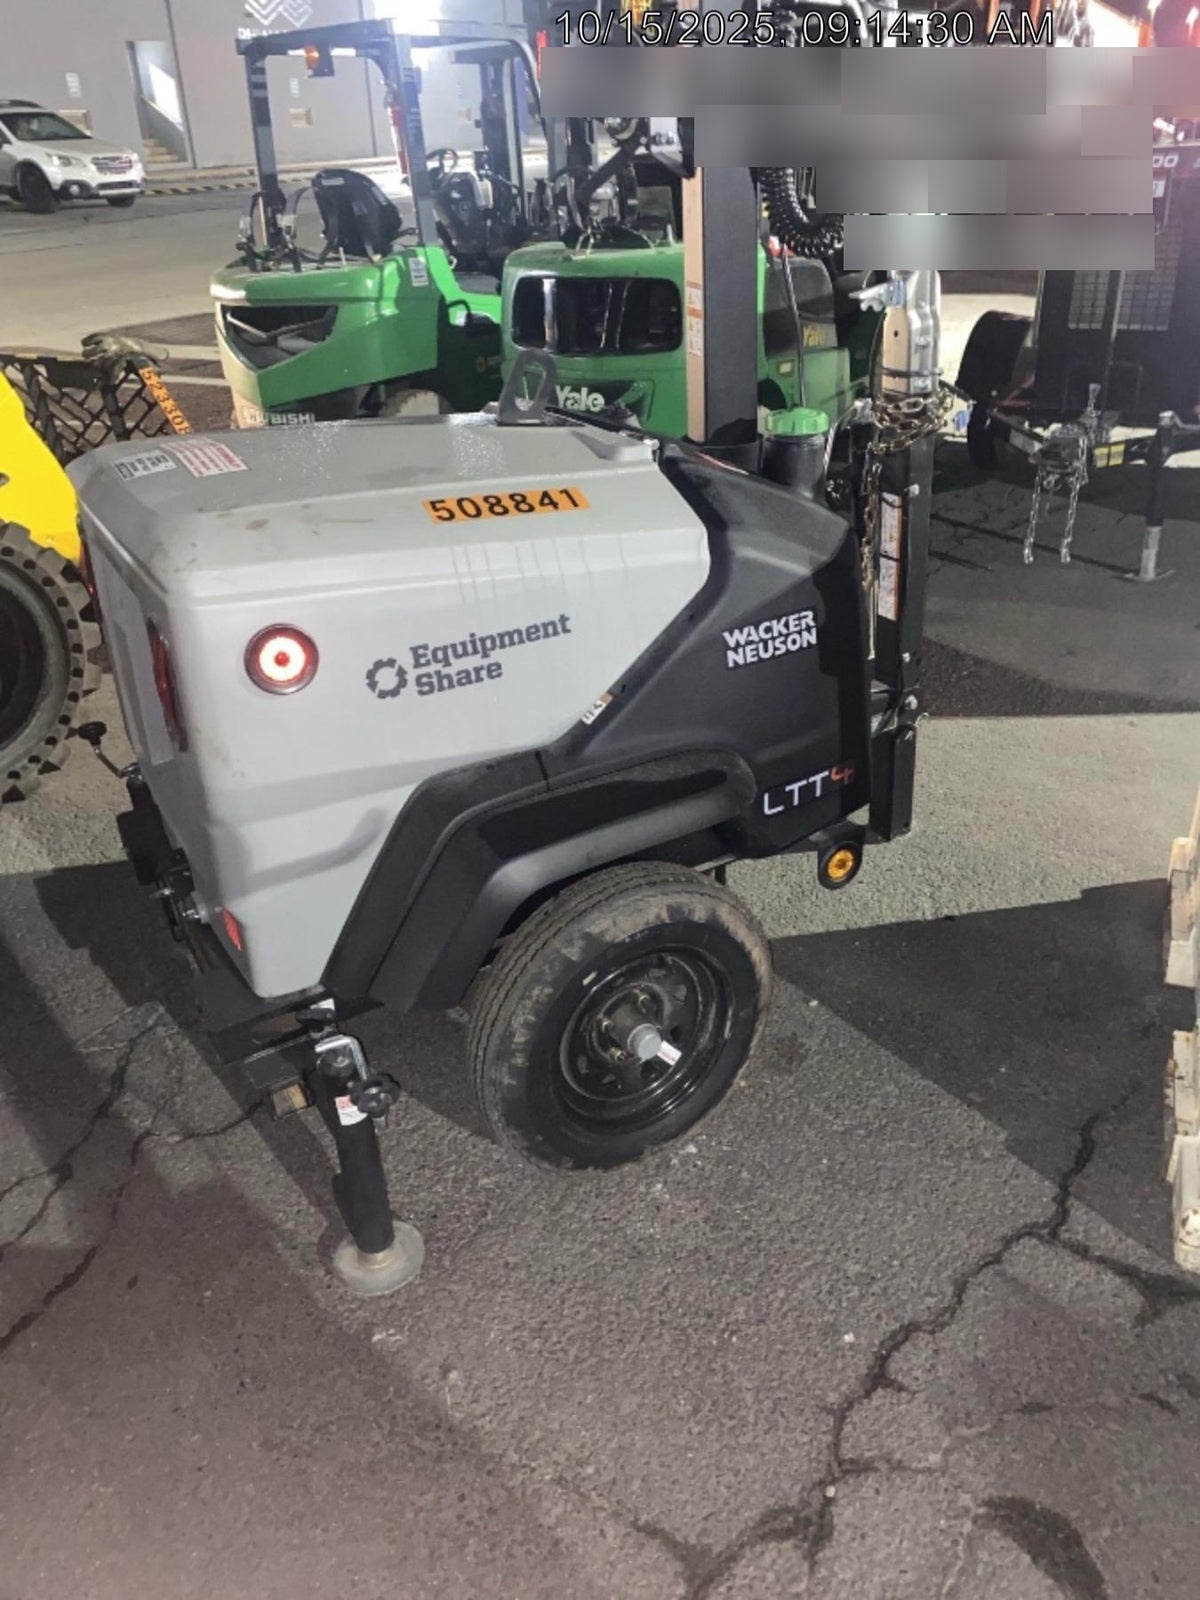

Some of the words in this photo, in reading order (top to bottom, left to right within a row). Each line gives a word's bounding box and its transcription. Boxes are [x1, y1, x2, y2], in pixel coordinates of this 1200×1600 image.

[554, 384, 606, 413] Yale
[429, 488, 580, 522] 508841
[409, 614, 572, 669] Equipment
[722, 610, 816, 648] WACKER
[726, 627, 818, 668] NEUSON
[414, 660, 504, 696] Share
